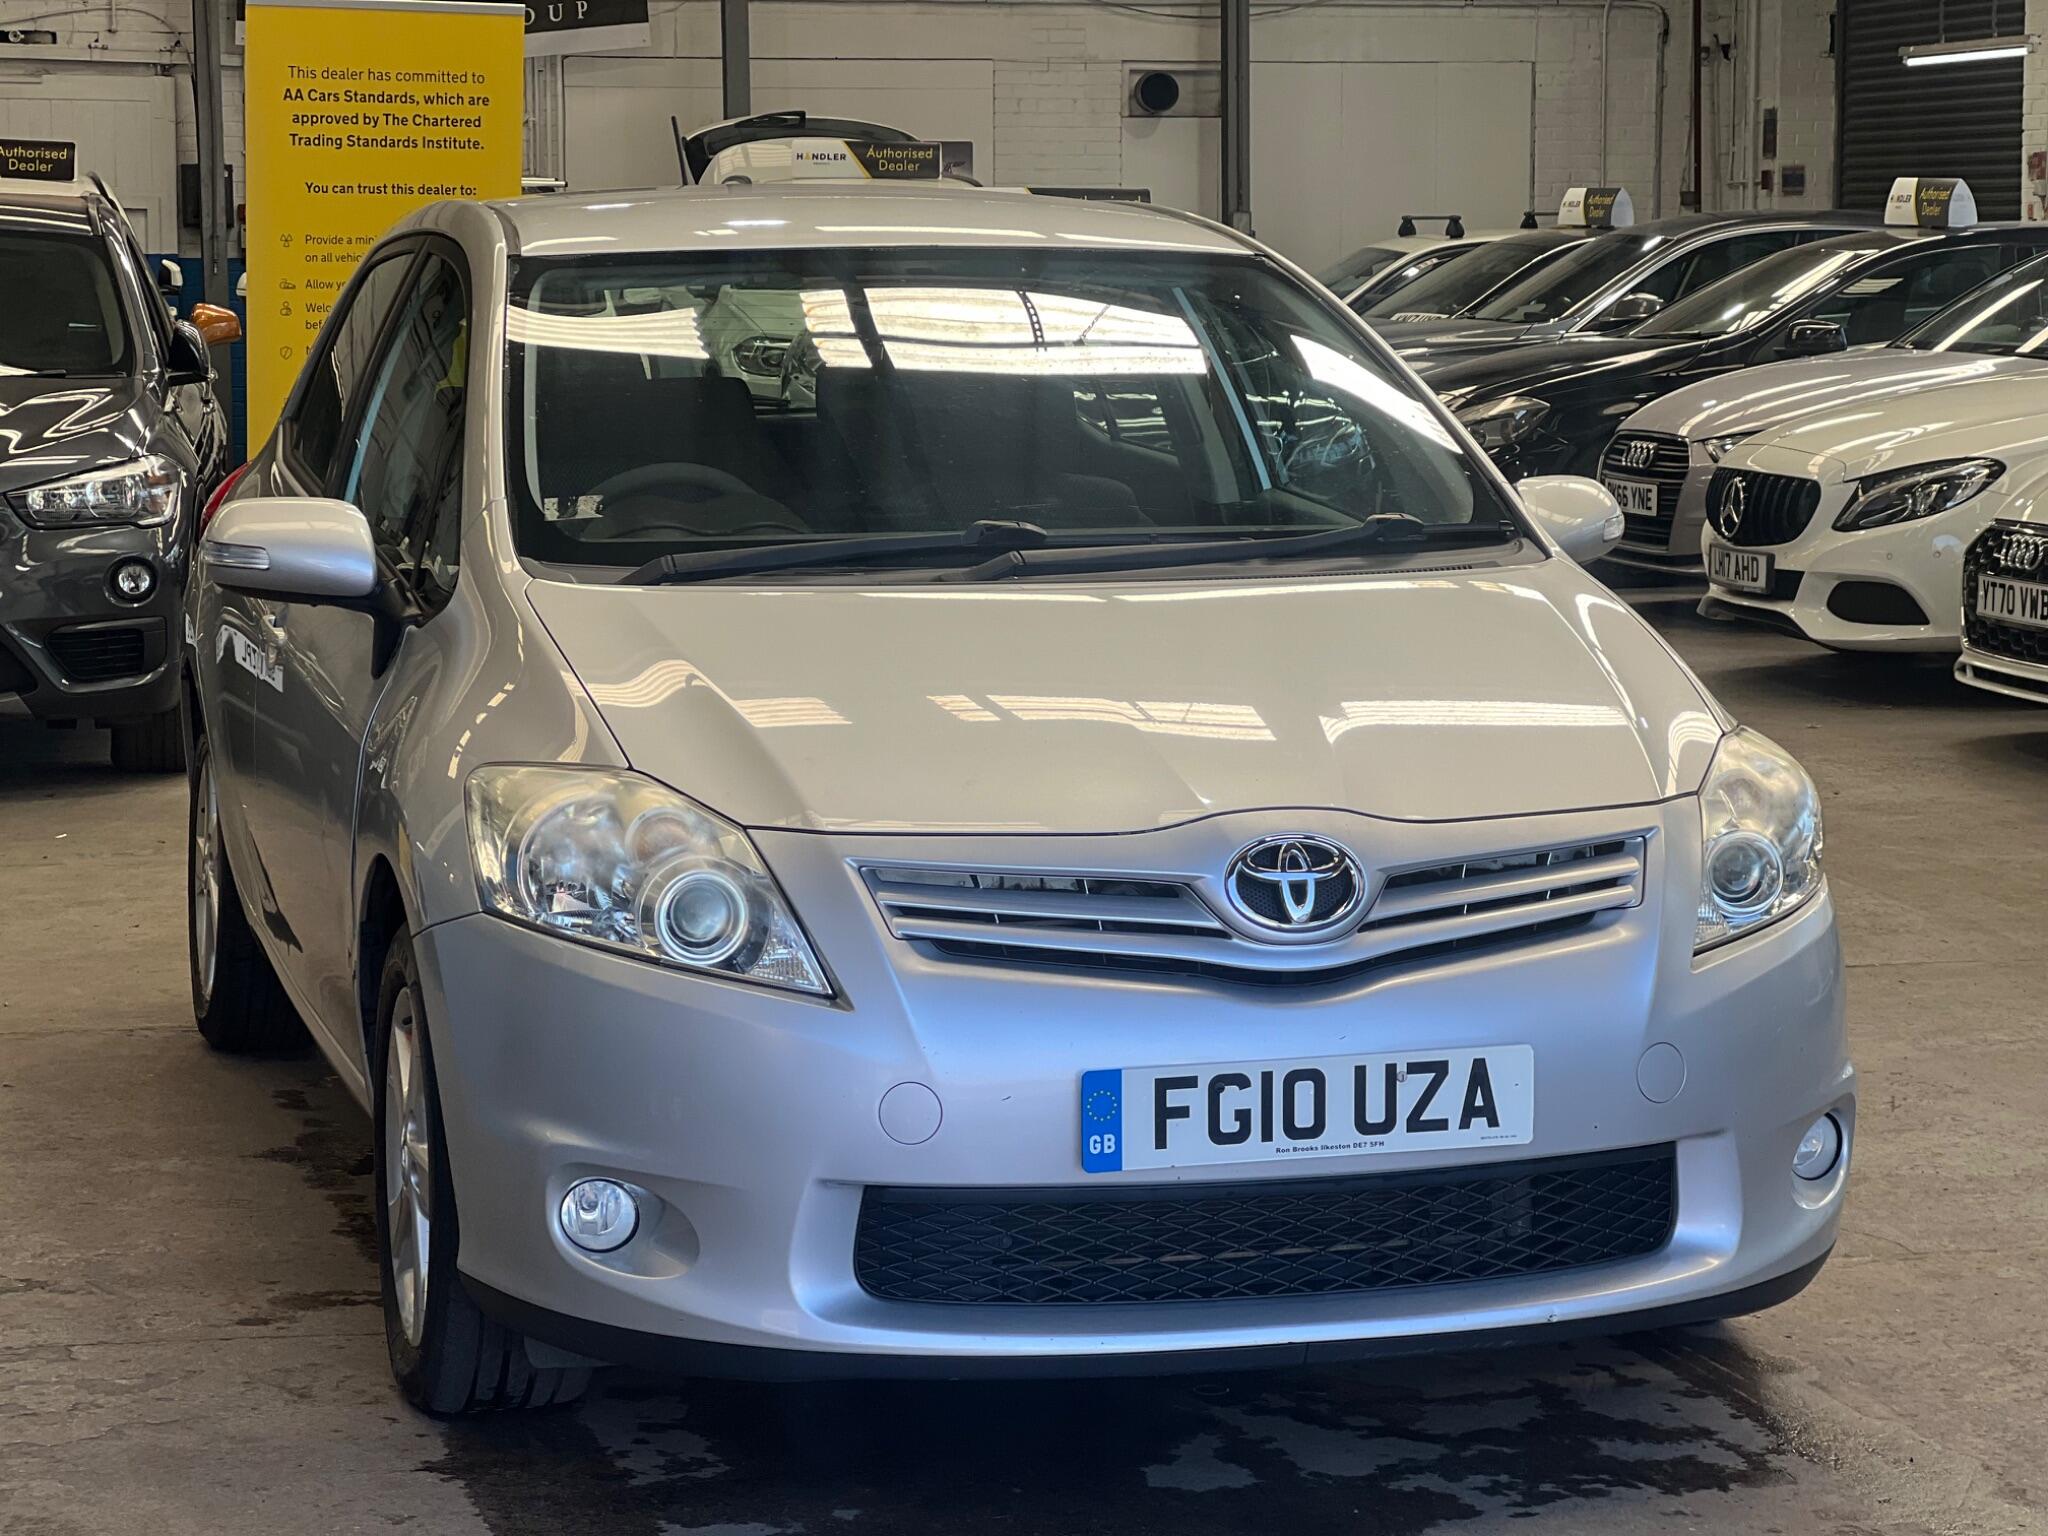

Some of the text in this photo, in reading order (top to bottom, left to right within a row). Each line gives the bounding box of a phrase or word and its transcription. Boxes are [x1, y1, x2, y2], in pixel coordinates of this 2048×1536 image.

[525, 1, 588, 25] OUP
[288, 66, 485, 84] This dealer has committed to
[283, 88, 490, 106] AA Cars Standards, which are
[292, 113, 481, 128] approved by The Chartered
[289, 133, 484, 150] Trading Standards Institute.
[0, 146, 67, 160] Authorised
[866, 146, 933, 159] Authorised
[8, 159, 53, 172] Dealer
[879, 160, 920, 171] Dealer
[305, 182, 477, 196] You can trust this dealer to:
[305, 234, 377, 245] Provide a min
[305, 253, 362, 263] on all vehic
[306, 279, 333, 289] Allow
[305, 303, 331, 313] Welc
[305, 320, 323, 329] bef
[1631, 486, 1653, 511] YNE
[1734, 554, 1759, 582] AHD
[1983, 579, 2048, 620] YT70 VWB
[1089, 1058, 1500, 1154] GB FG10 UZA
